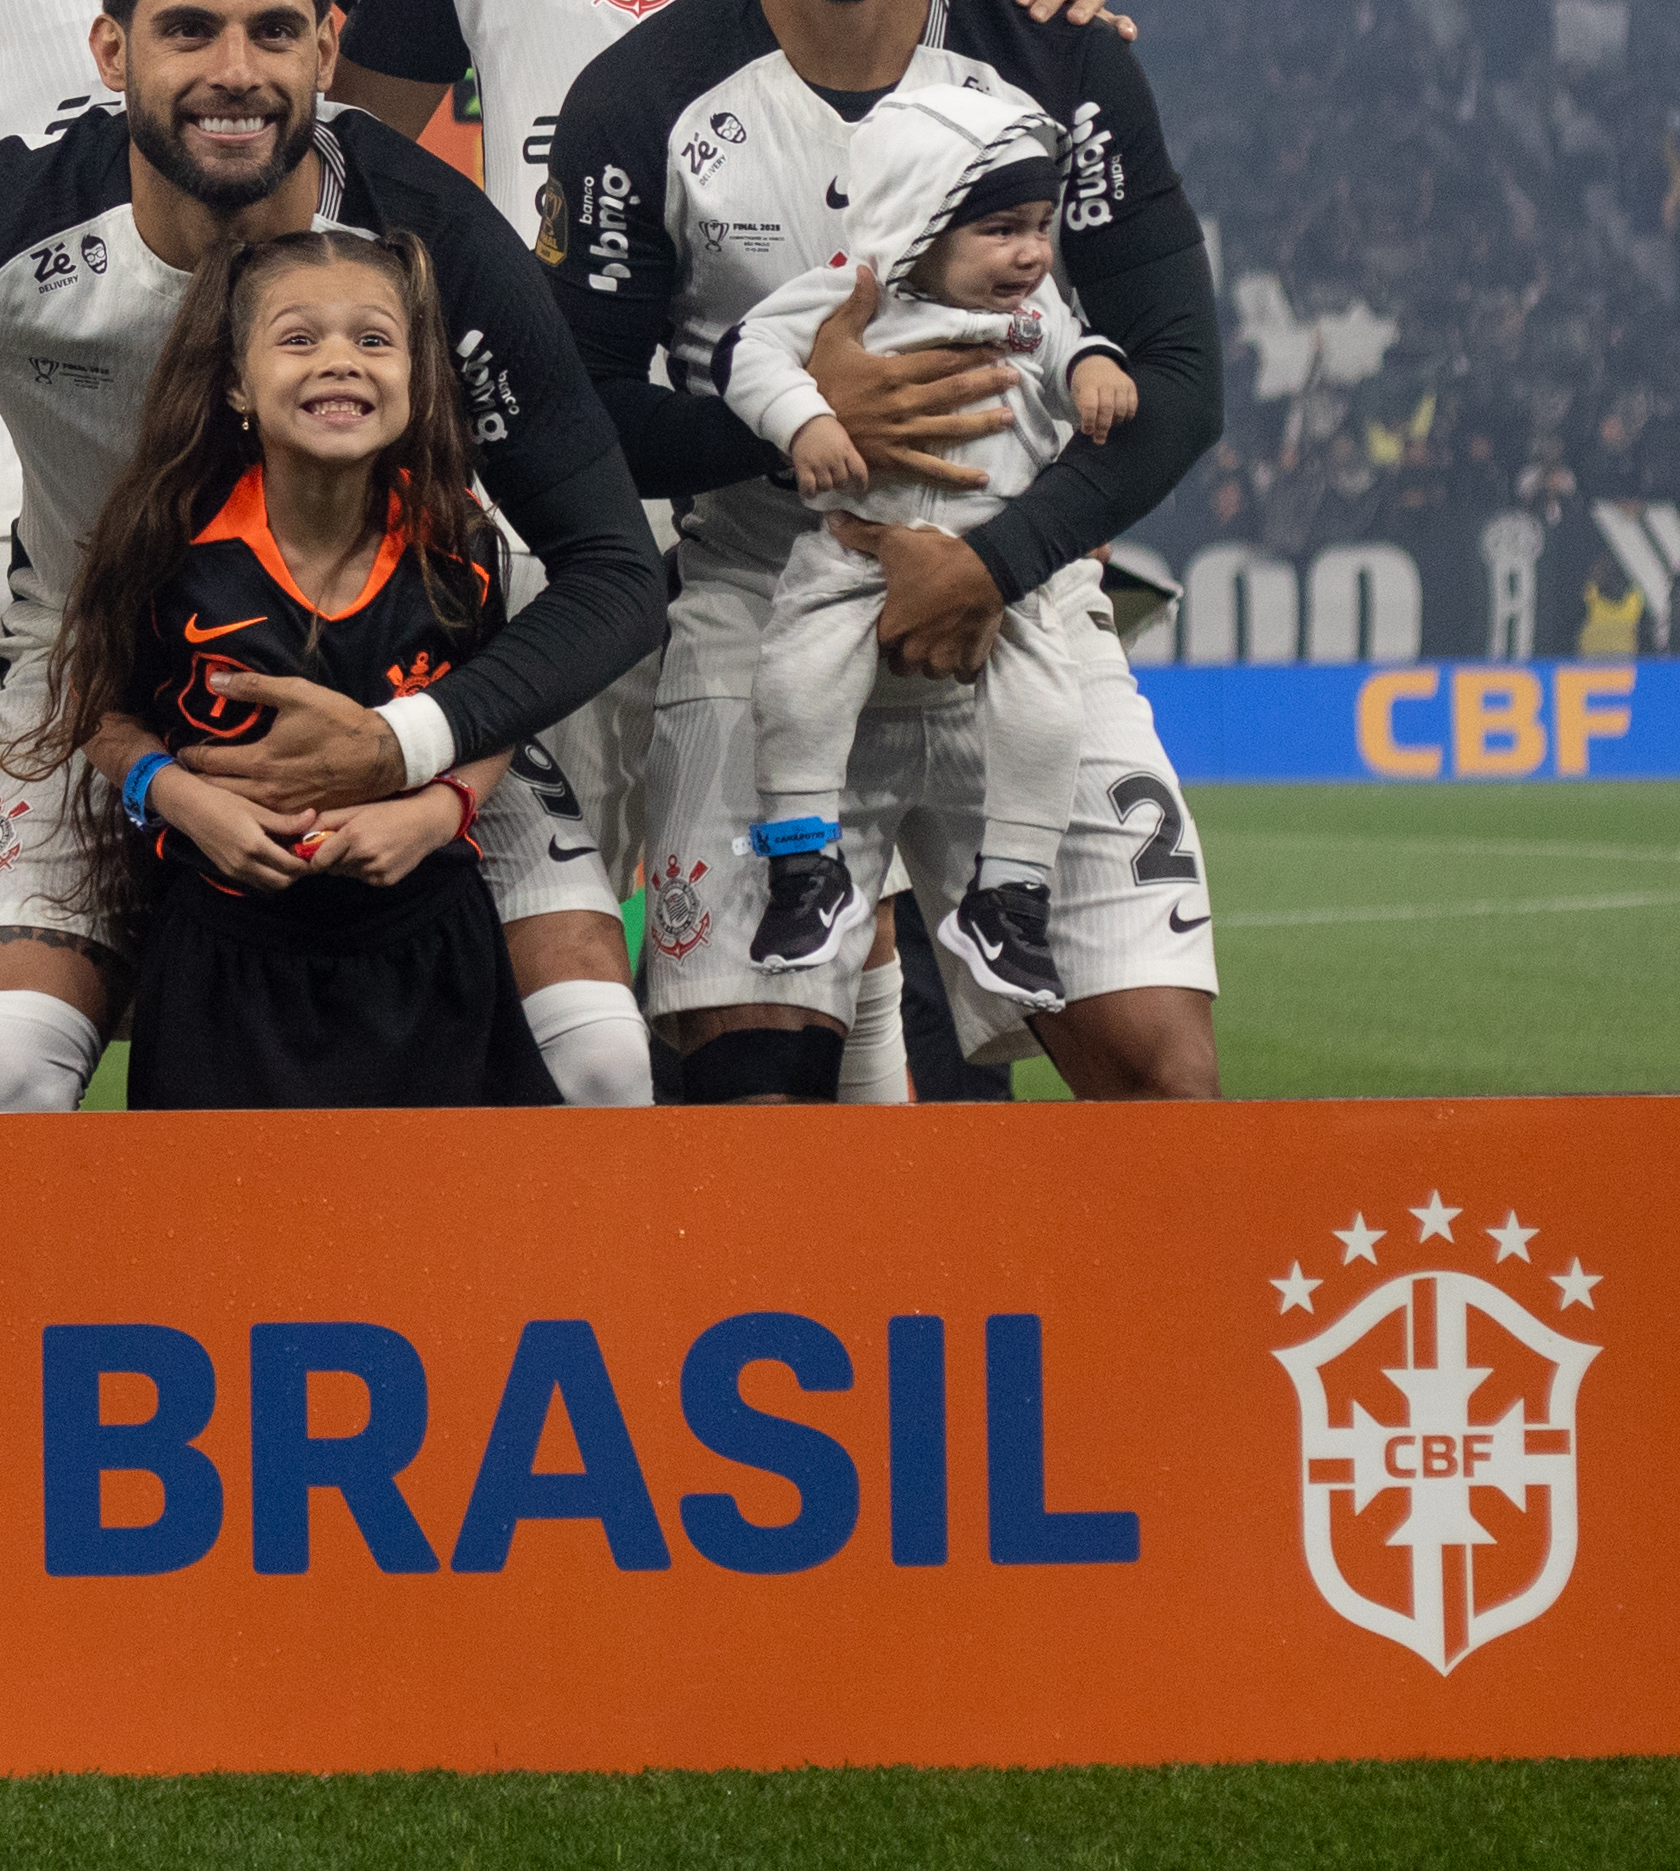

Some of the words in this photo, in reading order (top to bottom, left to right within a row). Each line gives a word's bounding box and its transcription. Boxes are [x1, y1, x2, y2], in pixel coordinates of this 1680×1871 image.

[681, 131, 719, 176] Zé
[578, 175, 595, 226] banco
[29, 241, 78, 284] Zé
[38, 274, 79, 295] DELIVERY
[1355, 666, 1637, 779] CBF
[42, 1309, 1142, 1577] BRASIL
[1382, 1428, 1497, 1486] CBF
